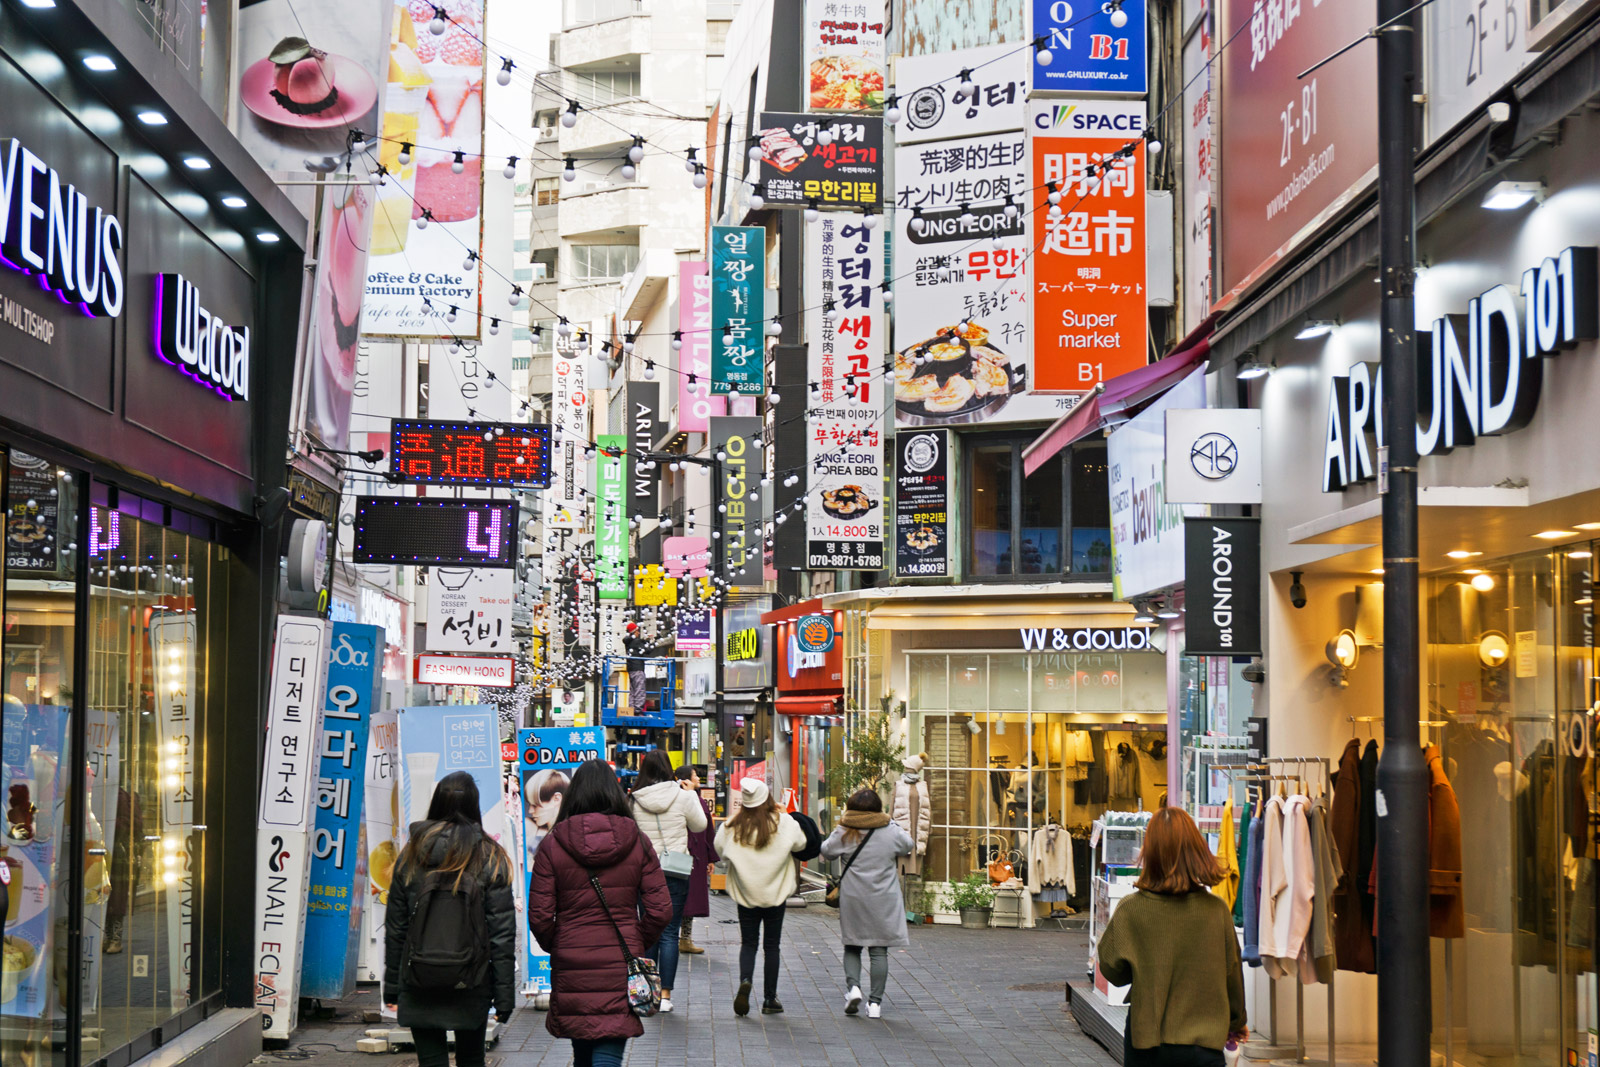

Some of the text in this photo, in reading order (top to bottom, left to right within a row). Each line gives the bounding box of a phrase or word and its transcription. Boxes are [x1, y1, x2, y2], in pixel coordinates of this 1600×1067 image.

[825, 3, 866, 18] 烤牛肉
[1089, 34, 1129, 60] B1
[1045, 71, 1129, 80] www.GHLUXURY.co.kr
[1073, 114, 1142, 130] SPACE
[812, 144, 877, 169] 생고기
[1043, 152, 1135, 198] 明洞
[804, 180, 876, 202] 무한리필
[1042, 210, 1134, 256] 超市
[837, 222, 871, 309] 엉터리
[967, 248, 1025, 281] 무한
[368, 272, 462, 285] offee & Cake
[1077, 268, 1101, 279] 明洞
[365, 284, 473, 299] emium factory
[1038, 282, 1143, 295] スーパーマーケット
[4, 297, 54, 344] MULTISHOP
[1062, 309, 1117, 330] Super
[1058, 331, 1121, 348] market
[726, 372, 748, 381] 명동점
[1078, 362, 1103, 382] B1
[713, 382, 761, 391] 7798286
[1323, 284, 1520, 493] ARUND
[814, 408, 877, 420] 두번째 이야기
[635, 403, 651, 496] ARITUM
[816, 454, 874, 463] UNGEORI
[855, 466, 878, 476] BBQ
[913, 512, 946, 524] 무한리필
[810, 555, 882, 567] 070-8871-6788
[442, 610, 502, 648] 설빙
[1020, 628, 1047, 650] W
[1052, 628, 1071, 650] &
[425, 664, 505, 677] FASHION HONG
[275, 657, 306, 804] 디저트 연구소
[569, 731, 596, 745] 美发
[450, 734, 487, 748] 디저트
[450, 750, 488, 764] 연구소
[524, 748, 598, 765] ODA HAIR
[313, 685, 360, 868] 오다헤어
[308, 884, 348, 898] 韩翻译
[307, 900, 332, 912] nglish
[539, 960, 552, 970] 欢
[256, 941, 281, 1012] ECLAT
